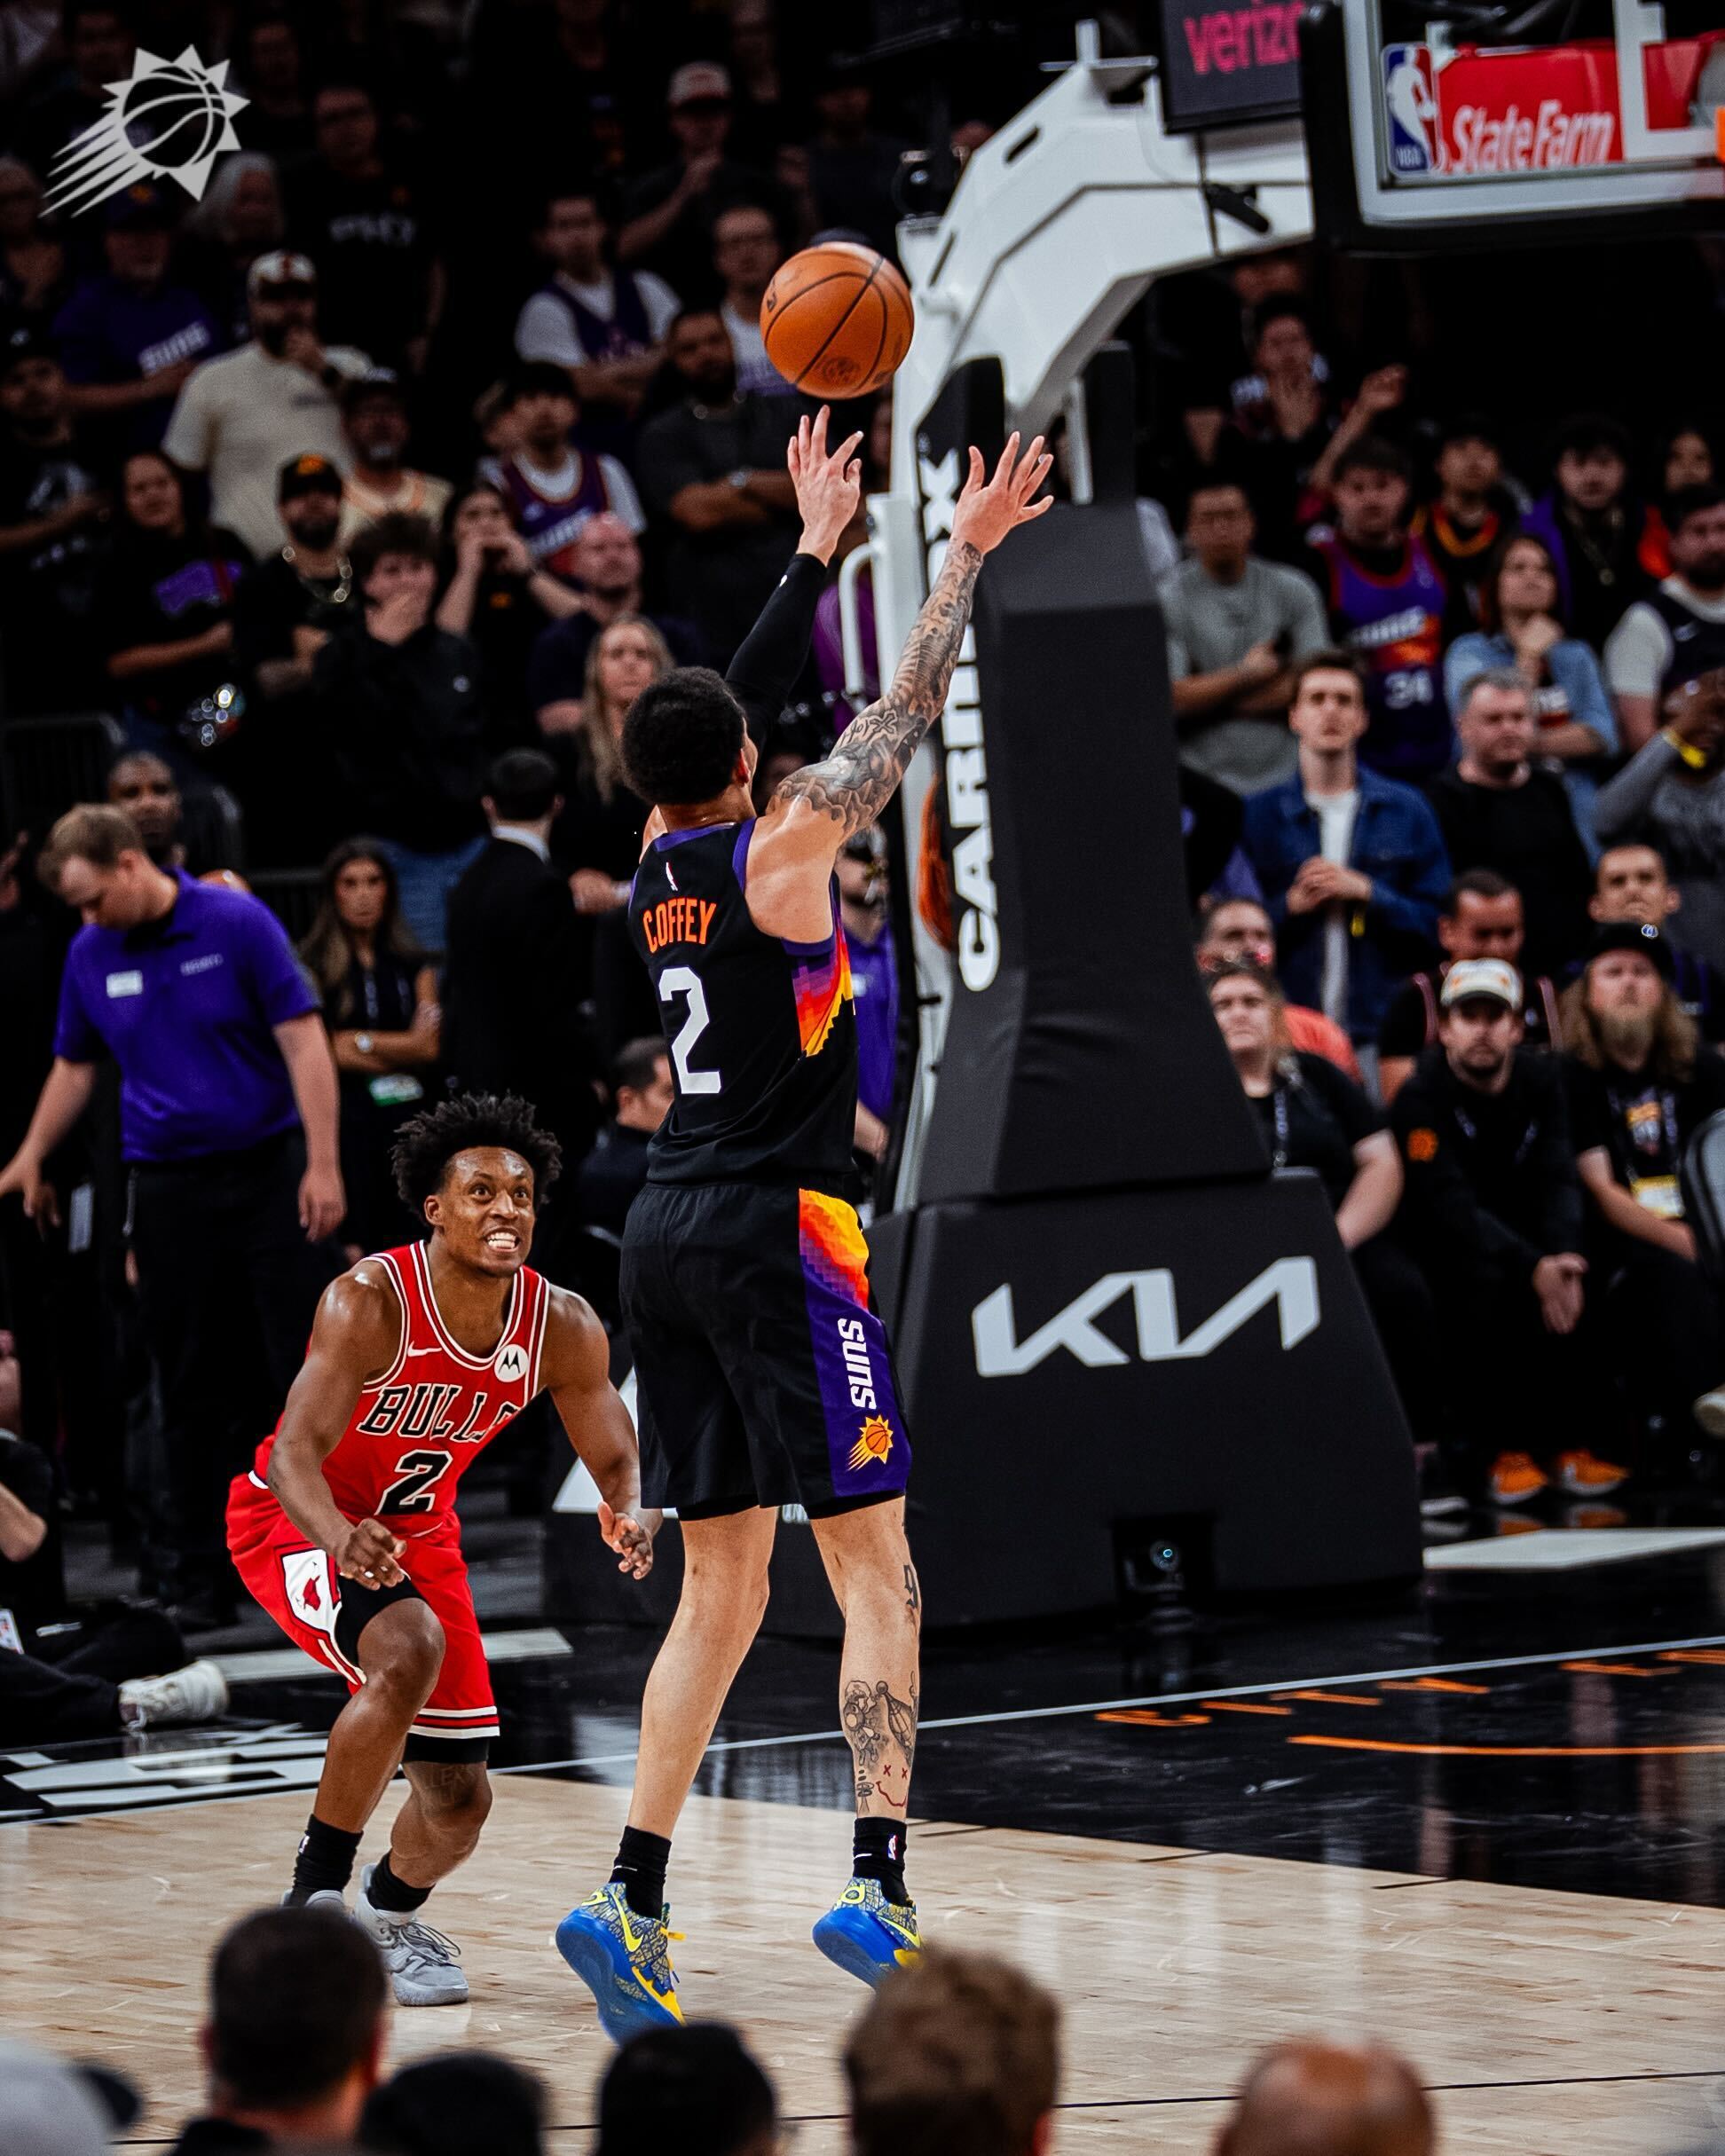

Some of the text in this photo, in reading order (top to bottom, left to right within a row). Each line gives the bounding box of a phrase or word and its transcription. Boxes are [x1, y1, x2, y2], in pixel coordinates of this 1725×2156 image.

[918, 447, 1000, 992] CARMX
[642, 897, 717, 954] COFFEY
[658, 966, 721, 1094] 2
[973, 1255, 1320, 1377] KIA
[374, 1449, 453, 1516] 2
